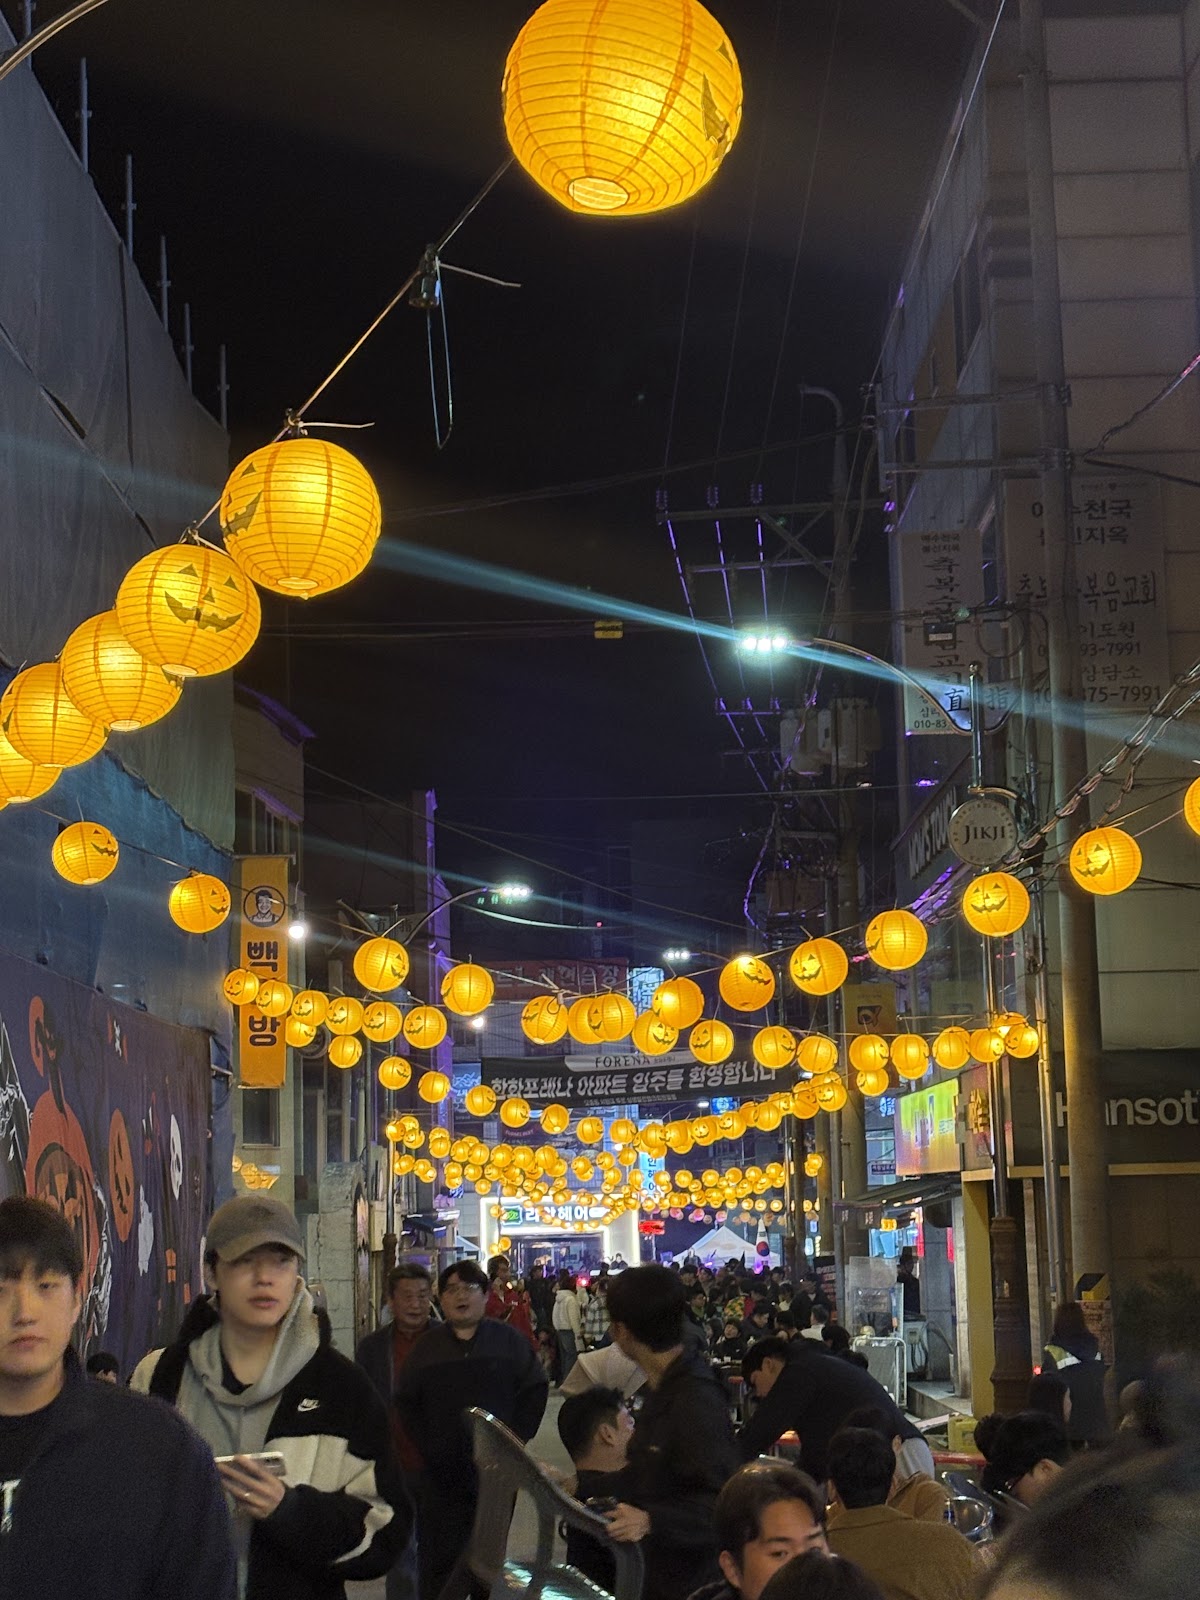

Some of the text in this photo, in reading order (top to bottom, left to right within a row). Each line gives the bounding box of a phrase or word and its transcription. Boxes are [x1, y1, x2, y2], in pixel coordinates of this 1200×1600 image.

[963, 825, 1006, 845] JIKJI
[247, 941, 281, 1046] 빽방
[595, 1055, 650, 1068] FORENA
[491, 1077, 574, 1100] 한화포레나
[577, 1074, 628, 1096] 아파트
[633, 1069, 684, 1093] 입주를
[1056, 1089, 1200, 1127] nsot
